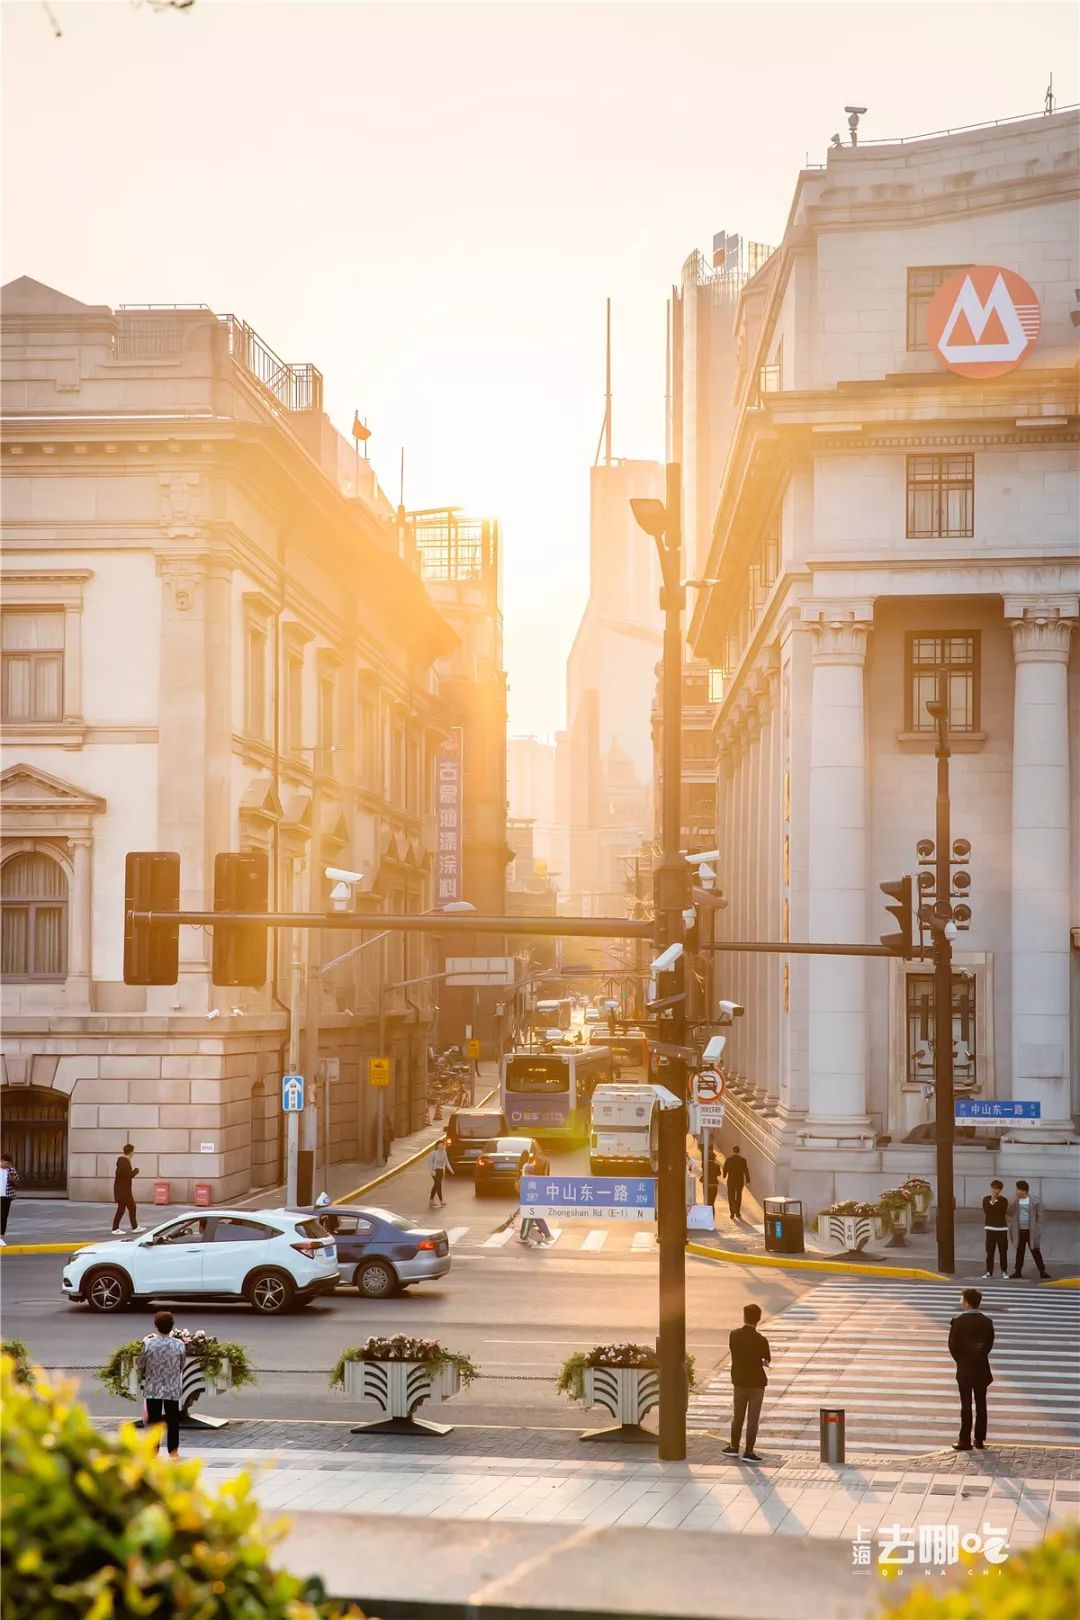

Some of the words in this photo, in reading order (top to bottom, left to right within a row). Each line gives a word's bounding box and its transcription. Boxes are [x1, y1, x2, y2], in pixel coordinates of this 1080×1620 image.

[971, 1103, 1024, 1116] 中山东一路
[637, 1182, 647, 1192] 北
[546, 1182, 629, 1203] 中山东一路
[529, 1207, 535, 1216] S
[548, 1207, 589, 1218] Zhongshan
[637, 1209, 644, 1218] N
